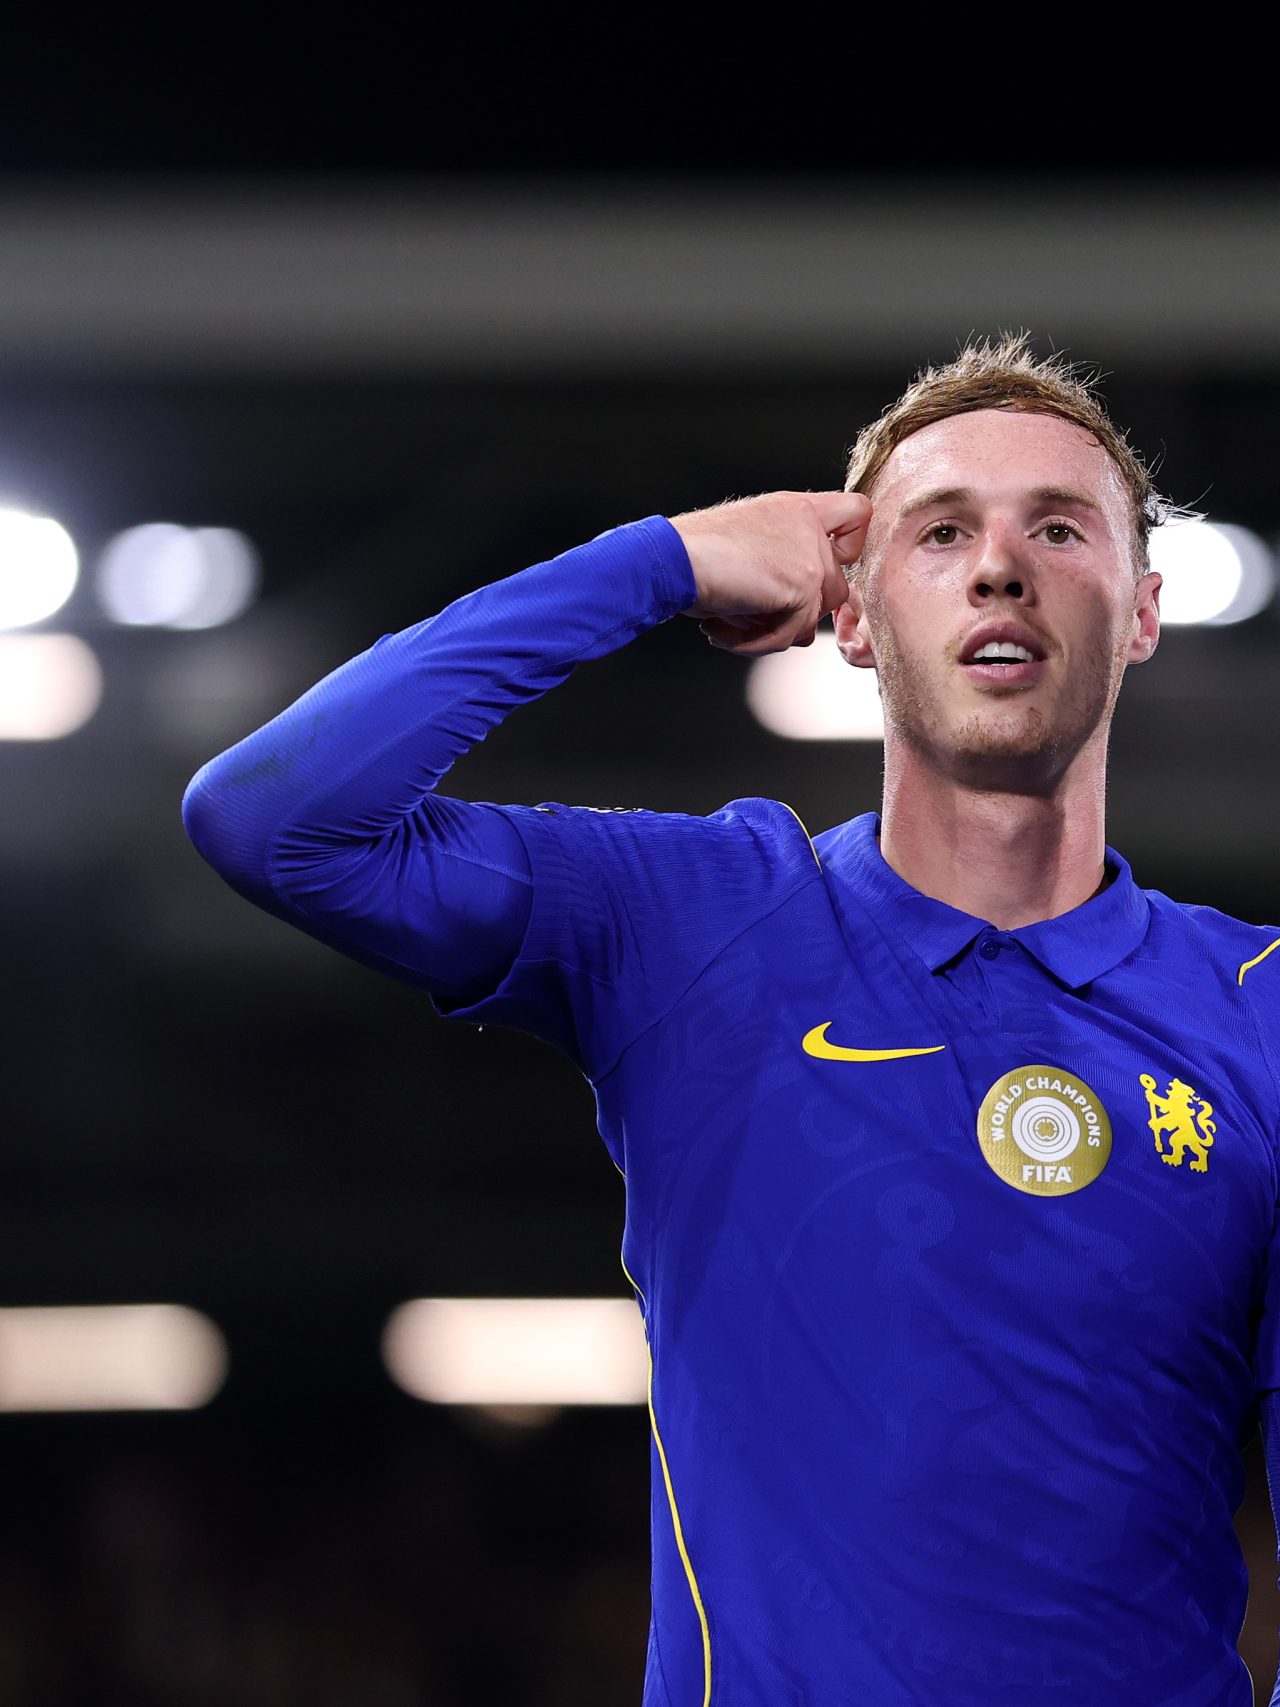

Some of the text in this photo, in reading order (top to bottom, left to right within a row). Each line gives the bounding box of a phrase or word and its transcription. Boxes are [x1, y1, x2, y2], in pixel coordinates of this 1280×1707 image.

[990, 1076, 1102, 1149] WORLD CHAMPIONS
[1021, 1164, 1073, 1184] FIFA
